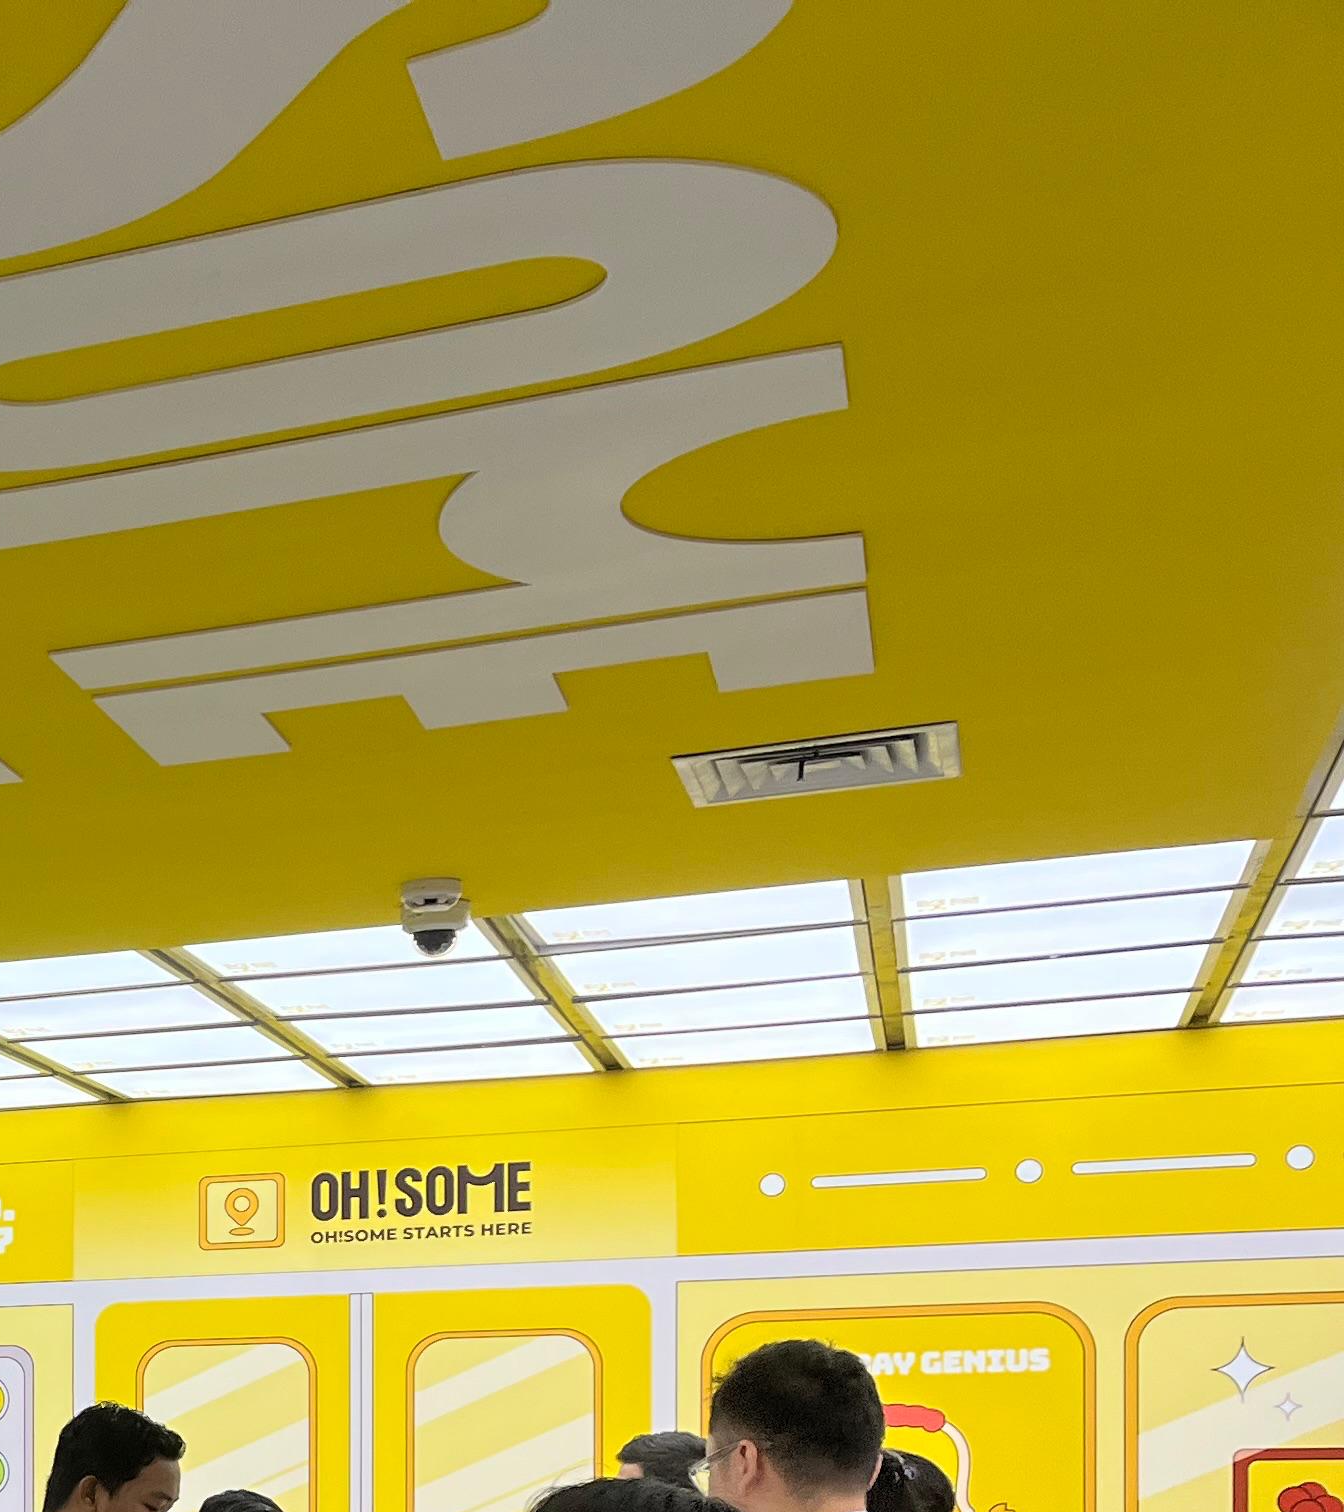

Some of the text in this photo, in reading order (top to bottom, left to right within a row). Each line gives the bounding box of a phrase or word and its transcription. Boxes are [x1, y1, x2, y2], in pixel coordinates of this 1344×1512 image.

[311, 1161, 531, 1221] OH!SOME
[311, 1222, 532, 1244] OH!SOME STARTS HERE
[921, 1347, 1051, 1374] GENIUS
